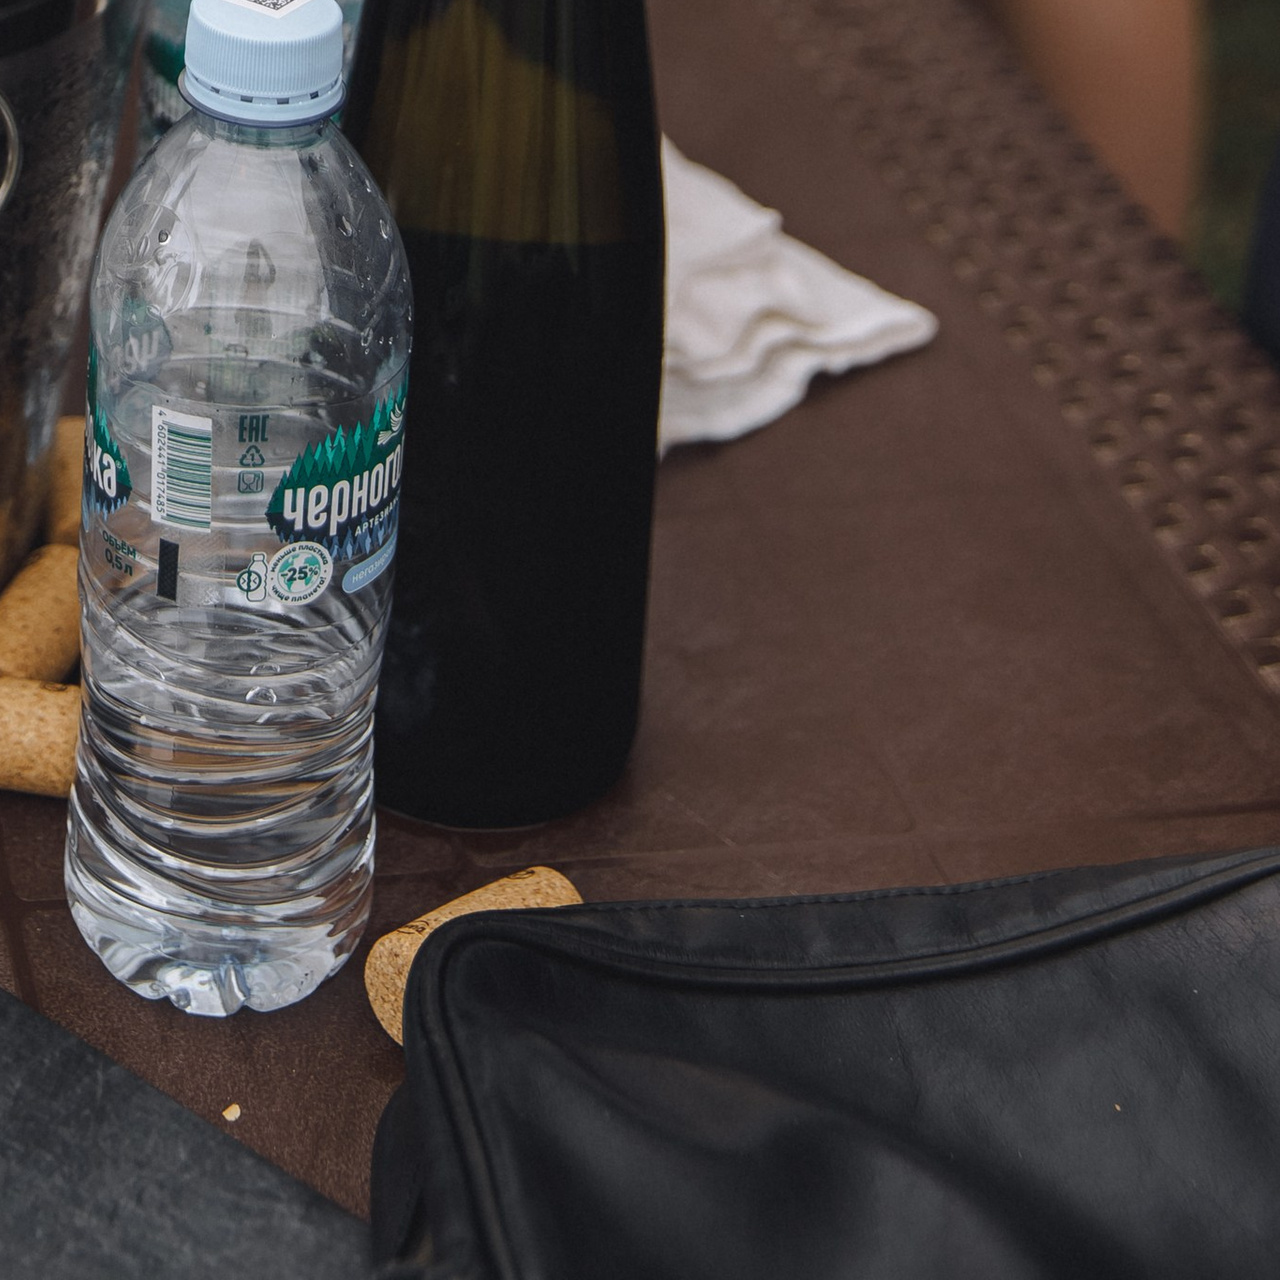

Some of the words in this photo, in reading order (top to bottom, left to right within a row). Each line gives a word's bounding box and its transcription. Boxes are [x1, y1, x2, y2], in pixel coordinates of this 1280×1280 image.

[238, 414, 270, 443] EAC
[157, 424, 167, 467] 602441
[156, 471, 166, 514] 017485
[102, 529, 137, 560] ОБЪЁМ
[270, 546, 297, 573] меньше
[298, 544, 329, 566] пластика
[105, 548, 123, 571] 0,5
[280, 565, 319, 582] -25%
[271, 584, 290, 602] чище
